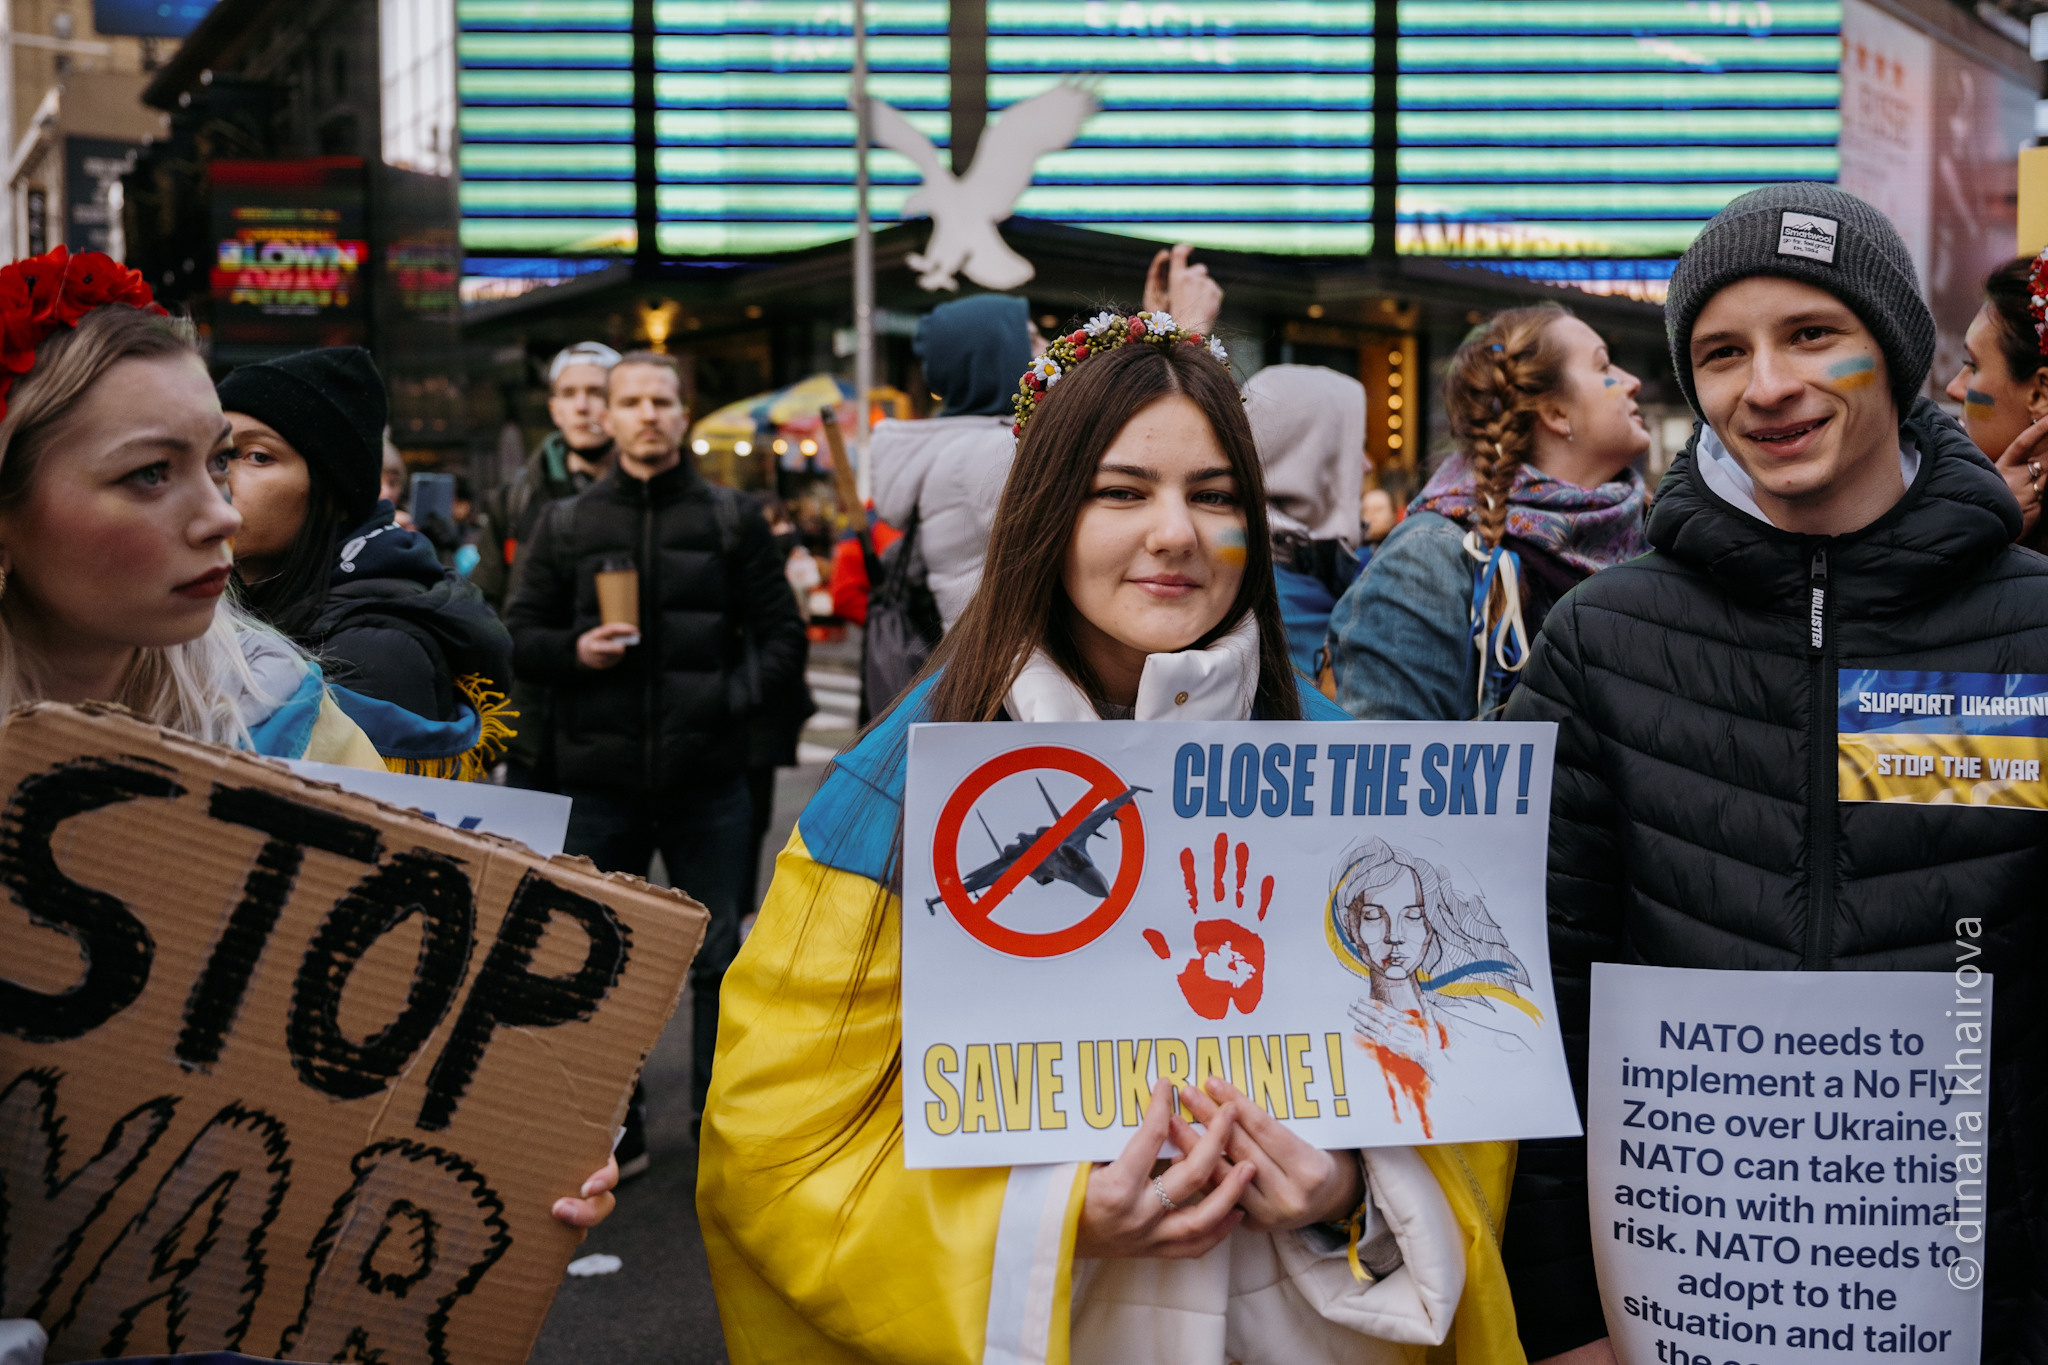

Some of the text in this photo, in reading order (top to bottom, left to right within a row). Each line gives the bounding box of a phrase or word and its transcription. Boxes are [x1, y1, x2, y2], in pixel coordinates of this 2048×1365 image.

[1811, 587, 1824, 649] HOLLISTER
[1859, 691, 1954, 715] SUPPORT
[1172, 742, 1317, 819] CLOSE
[1328, 744, 1410, 818] THE
[1878, 753, 2040, 781] STOP THE WAR
[0, 755, 634, 1131] STOP
[1659, 1020, 1924, 1056] NATO needs to
[924, 1041, 1067, 1135] SAVE
[1620, 1056, 1958, 1106] implement a No Fly
[1622, 1099, 1957, 1141] Zone over Ukraine.
[1619, 1140, 1958, 1184] NATO can take this
[1614, 1183, 1960, 1226] action with minimal
[1613, 1219, 1961, 1268] risk. NATO needs to
[1678, 1272, 1898, 1311] adopt to the
[1623, 1294, 1952, 1353] situation and tailor
